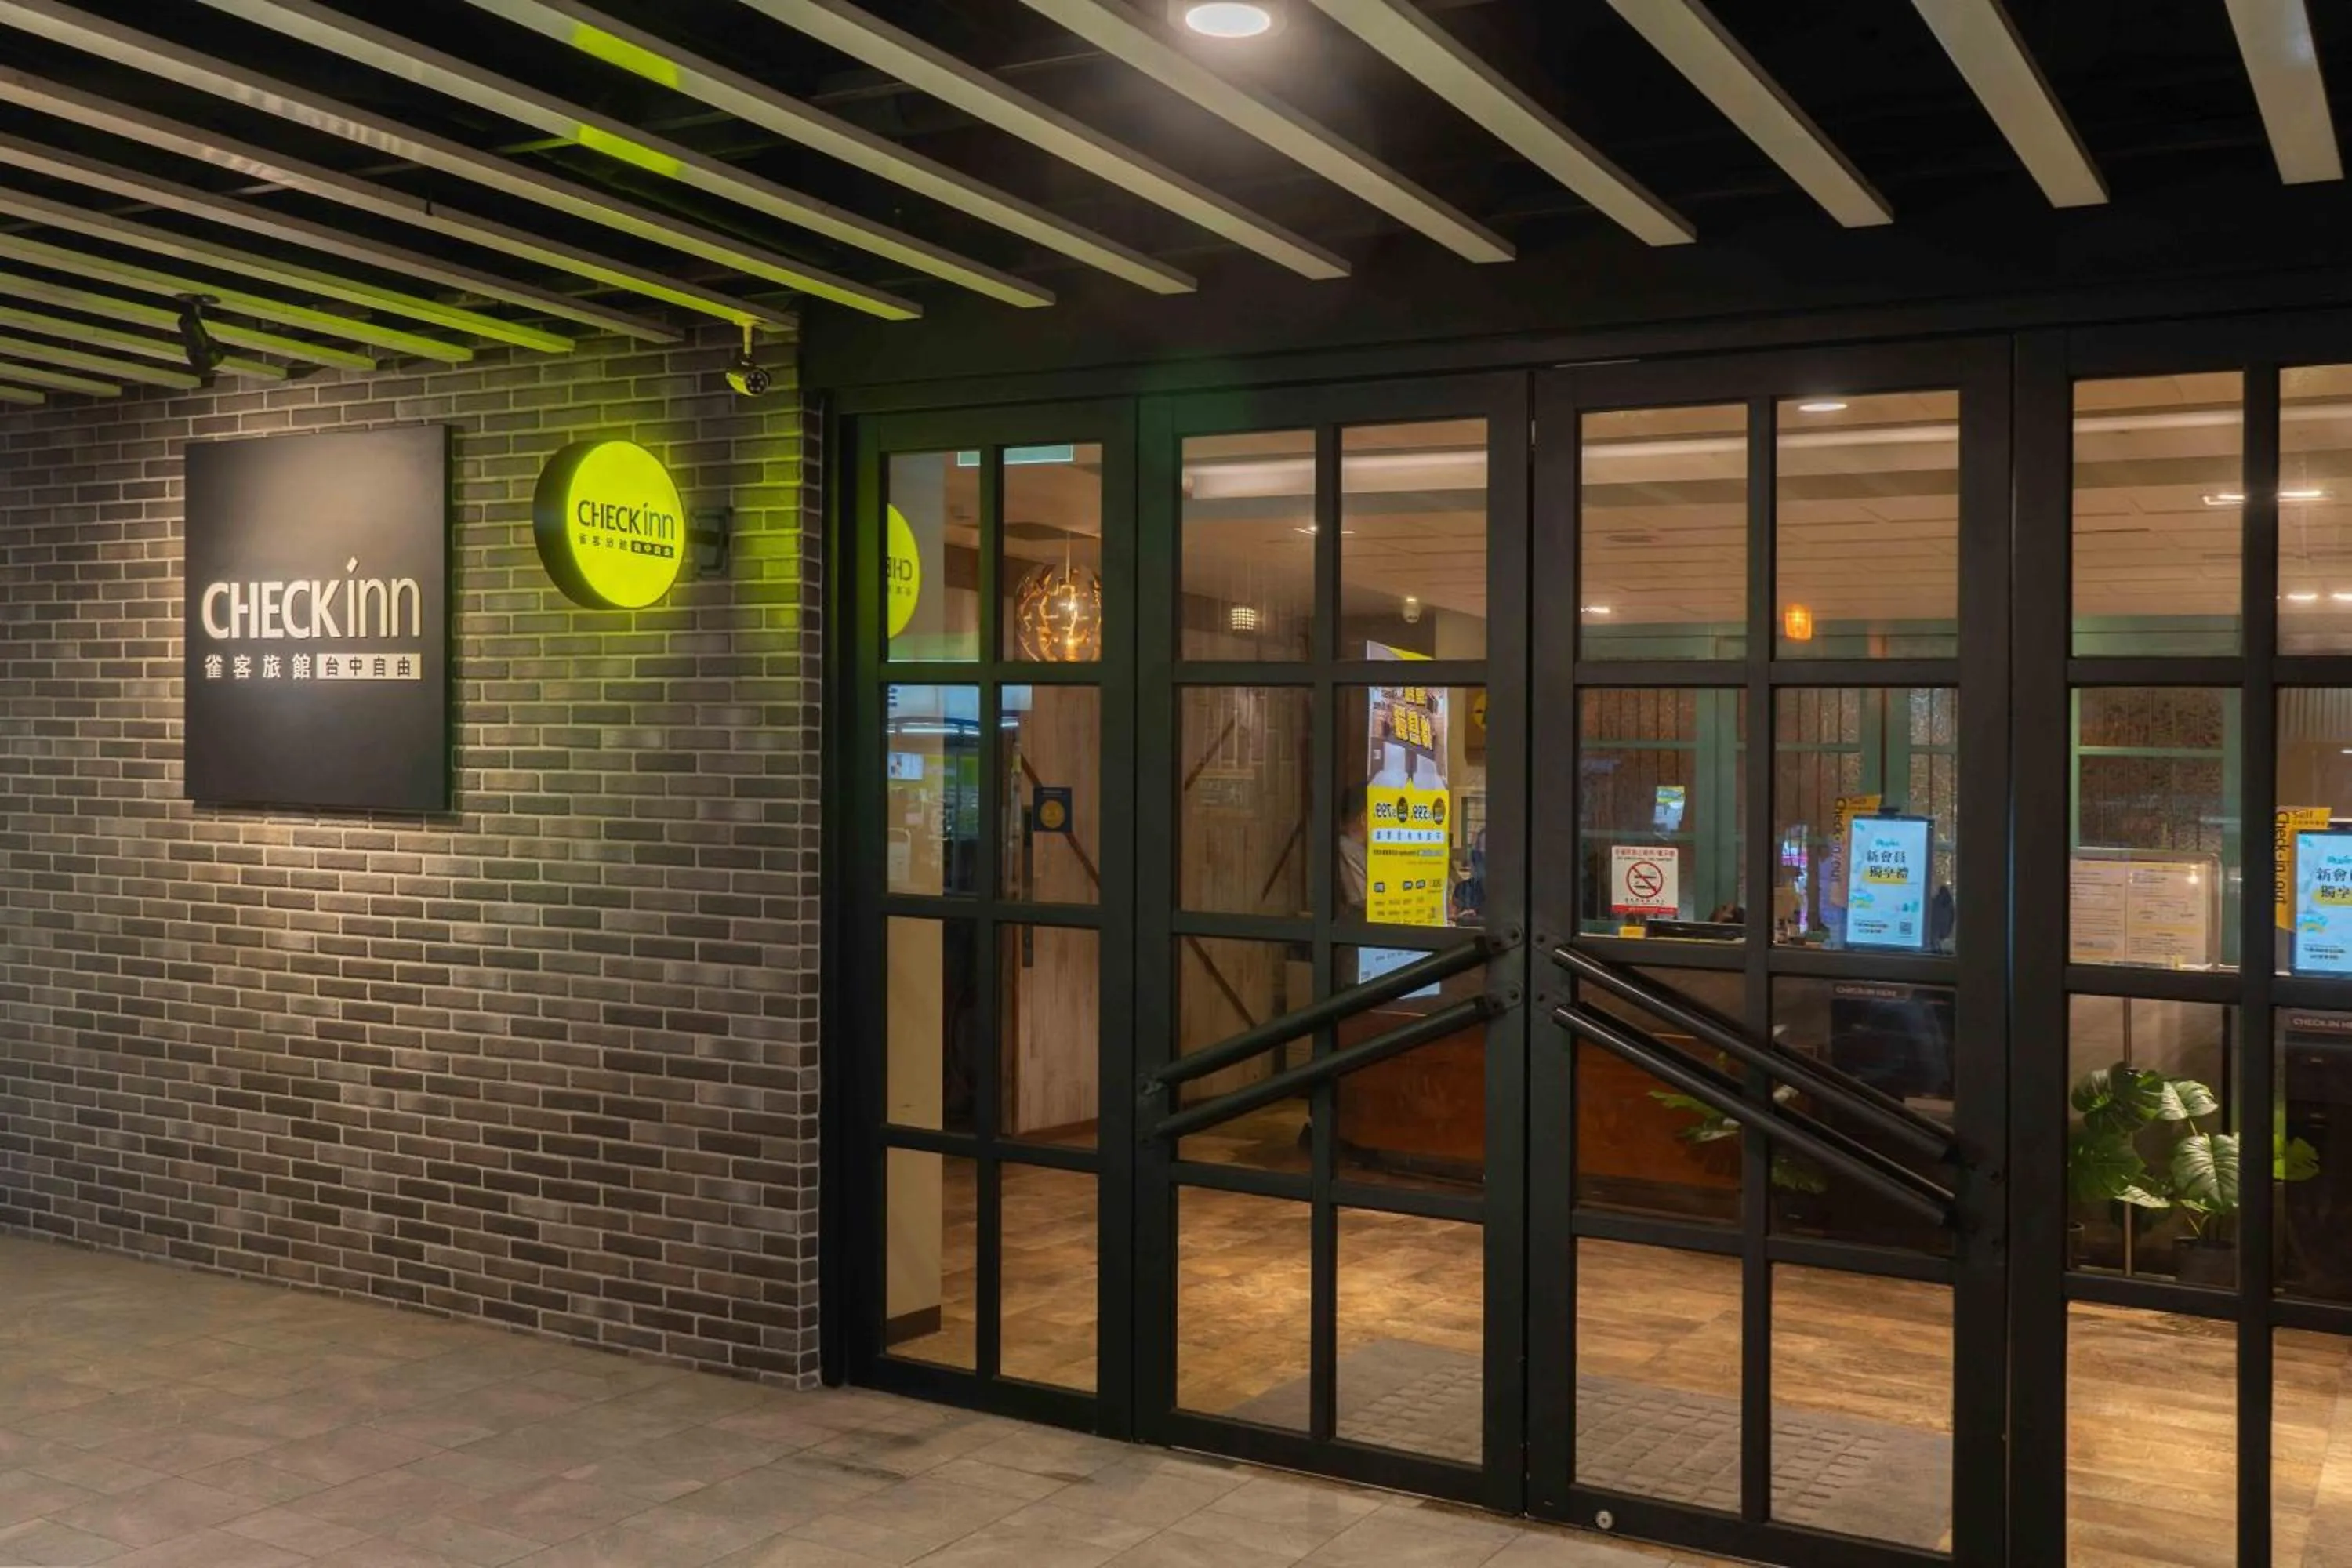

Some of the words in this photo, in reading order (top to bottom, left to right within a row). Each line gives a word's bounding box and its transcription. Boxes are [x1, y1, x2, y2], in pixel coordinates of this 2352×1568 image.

[204, 653, 312, 680] 雀客旅館
[325, 655, 412, 678] 台中自由
[2316, 867, 2352, 882] 新會
